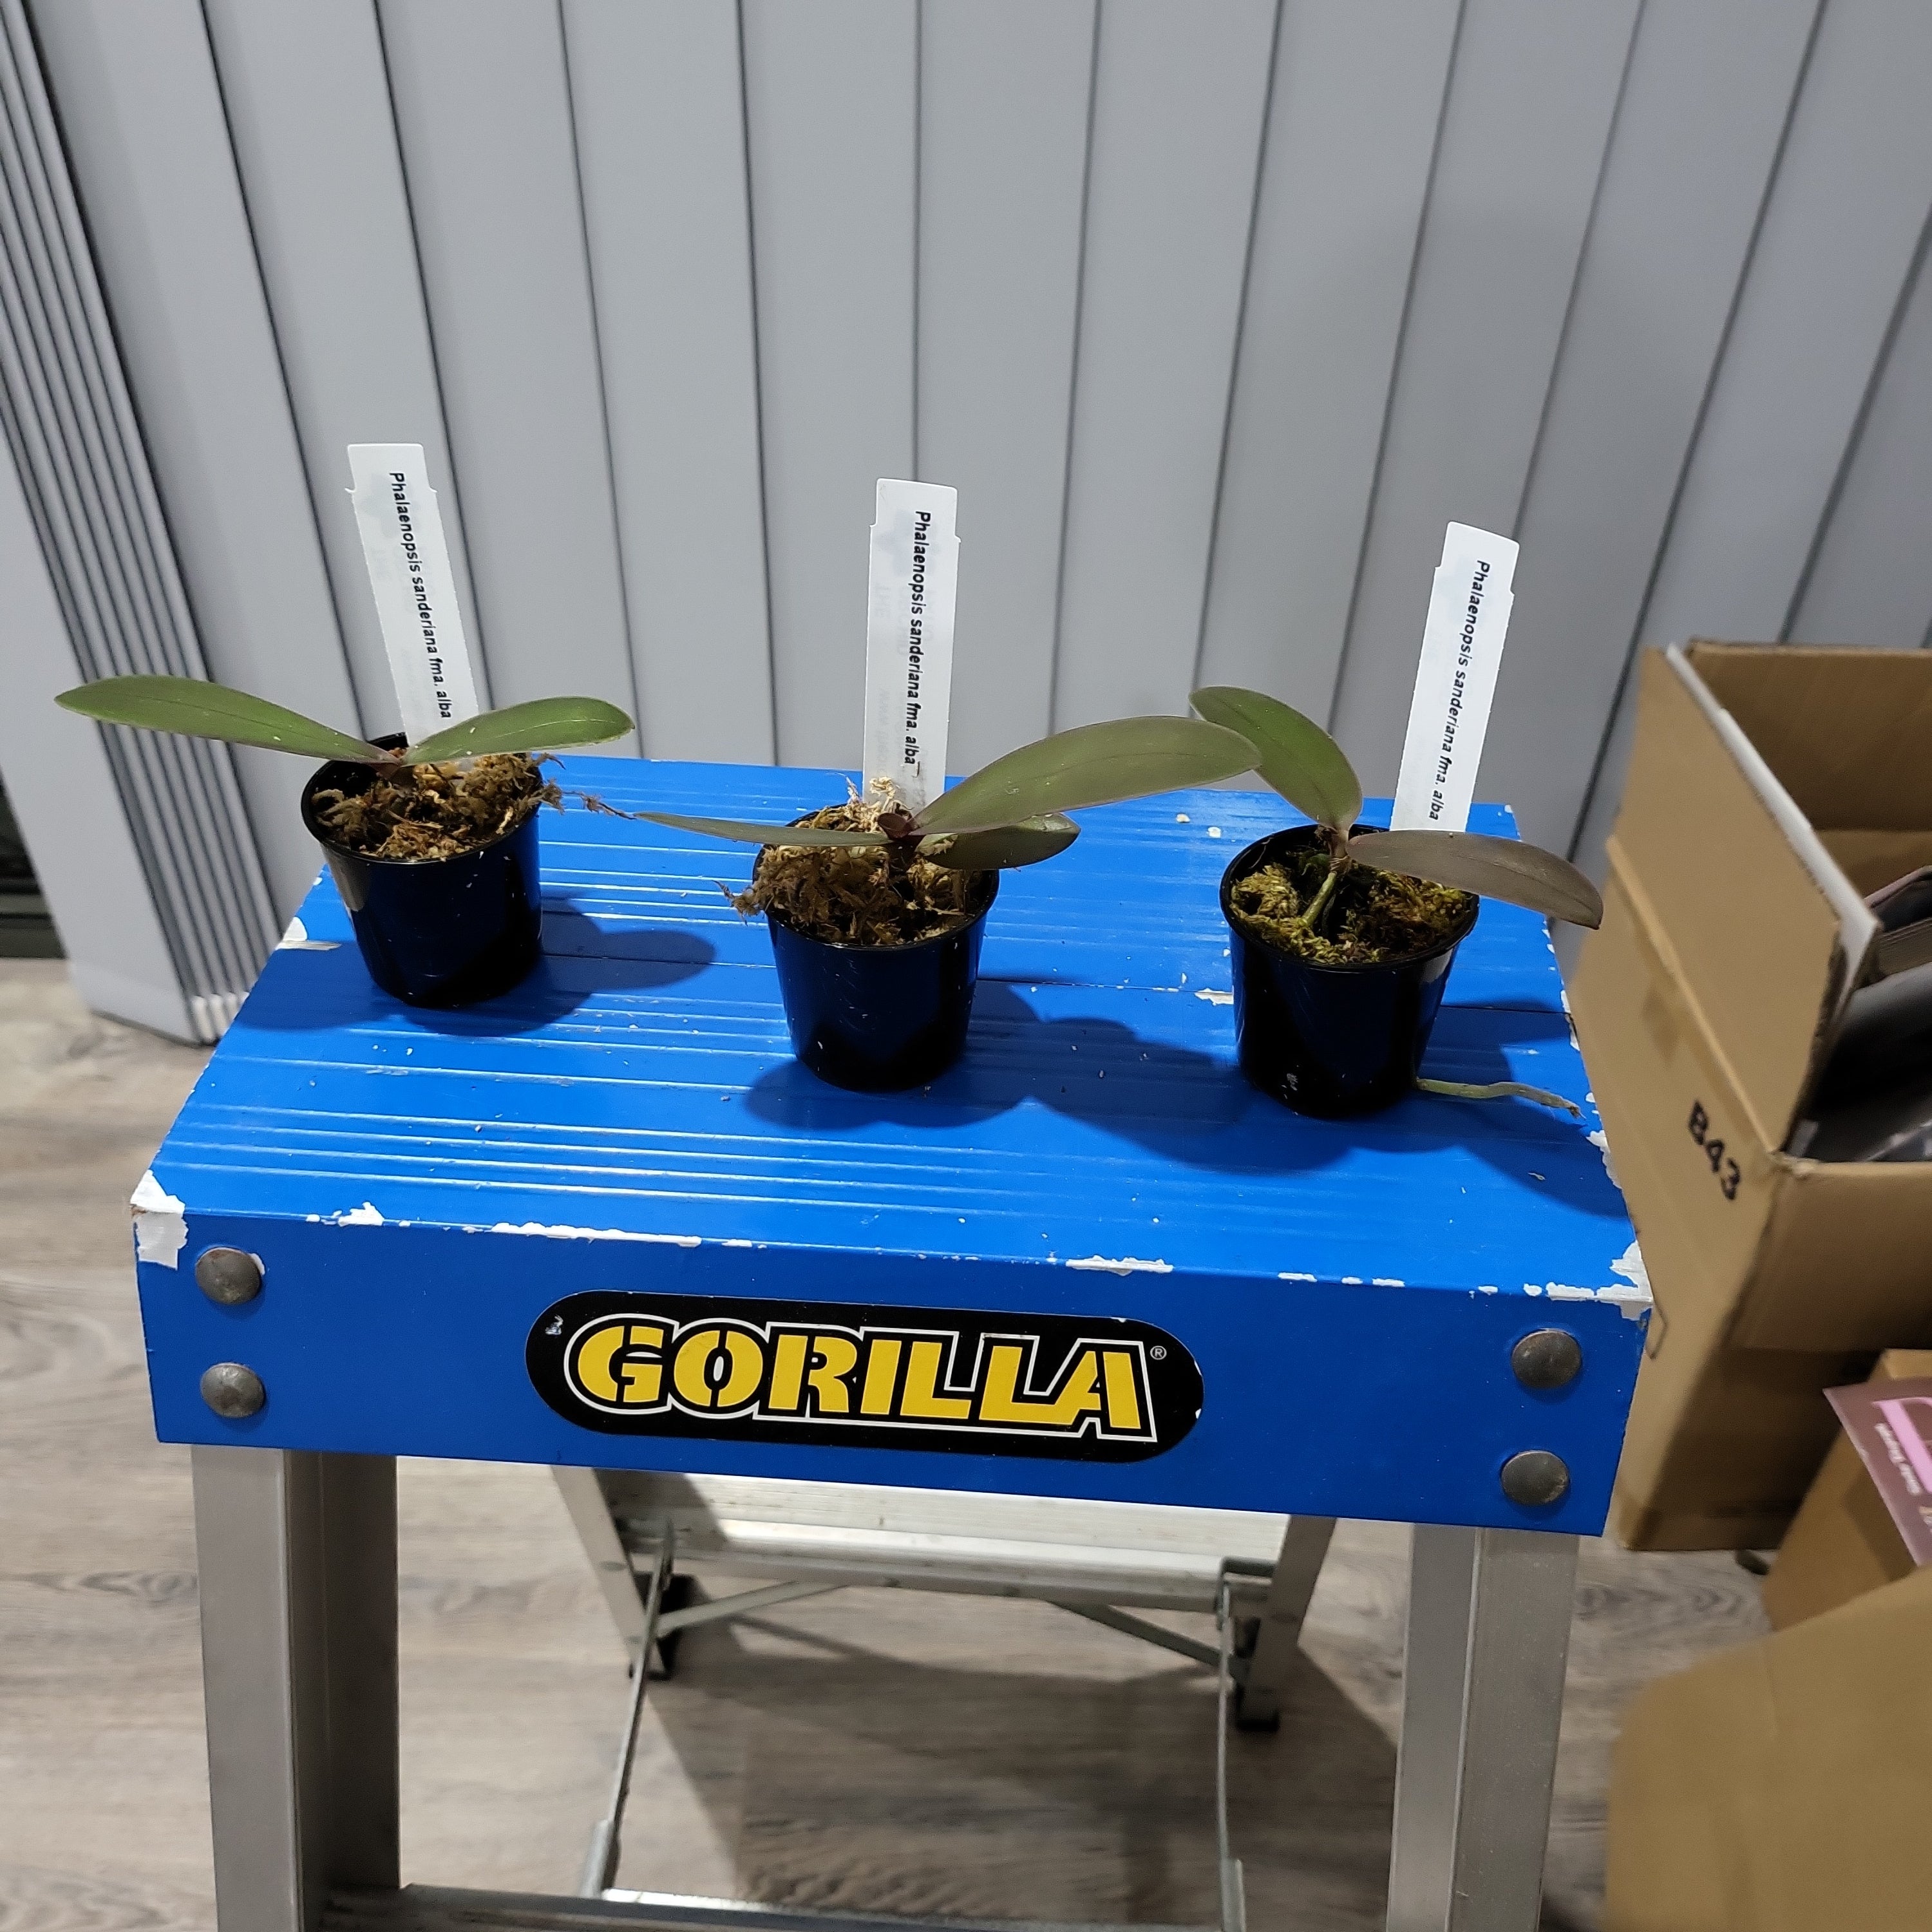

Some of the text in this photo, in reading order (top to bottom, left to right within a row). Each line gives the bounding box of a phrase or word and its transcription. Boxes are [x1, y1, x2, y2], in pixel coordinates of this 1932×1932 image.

[389, 472, 453, 719] Phalaenopsis sanderiana fma. alba
[907, 511, 931, 614] Phalaenopsis
[907, 619, 924, 699] sanderiana
[1428, 560, 1490, 821] Phalaenopsis sanderiana fma. alba
[904, 735, 920, 765] alba
[905, 703, 922, 732] fma.
[1689, 1100, 1740, 1200] B43
[571, 1319, 1150, 1436] GORILLA
